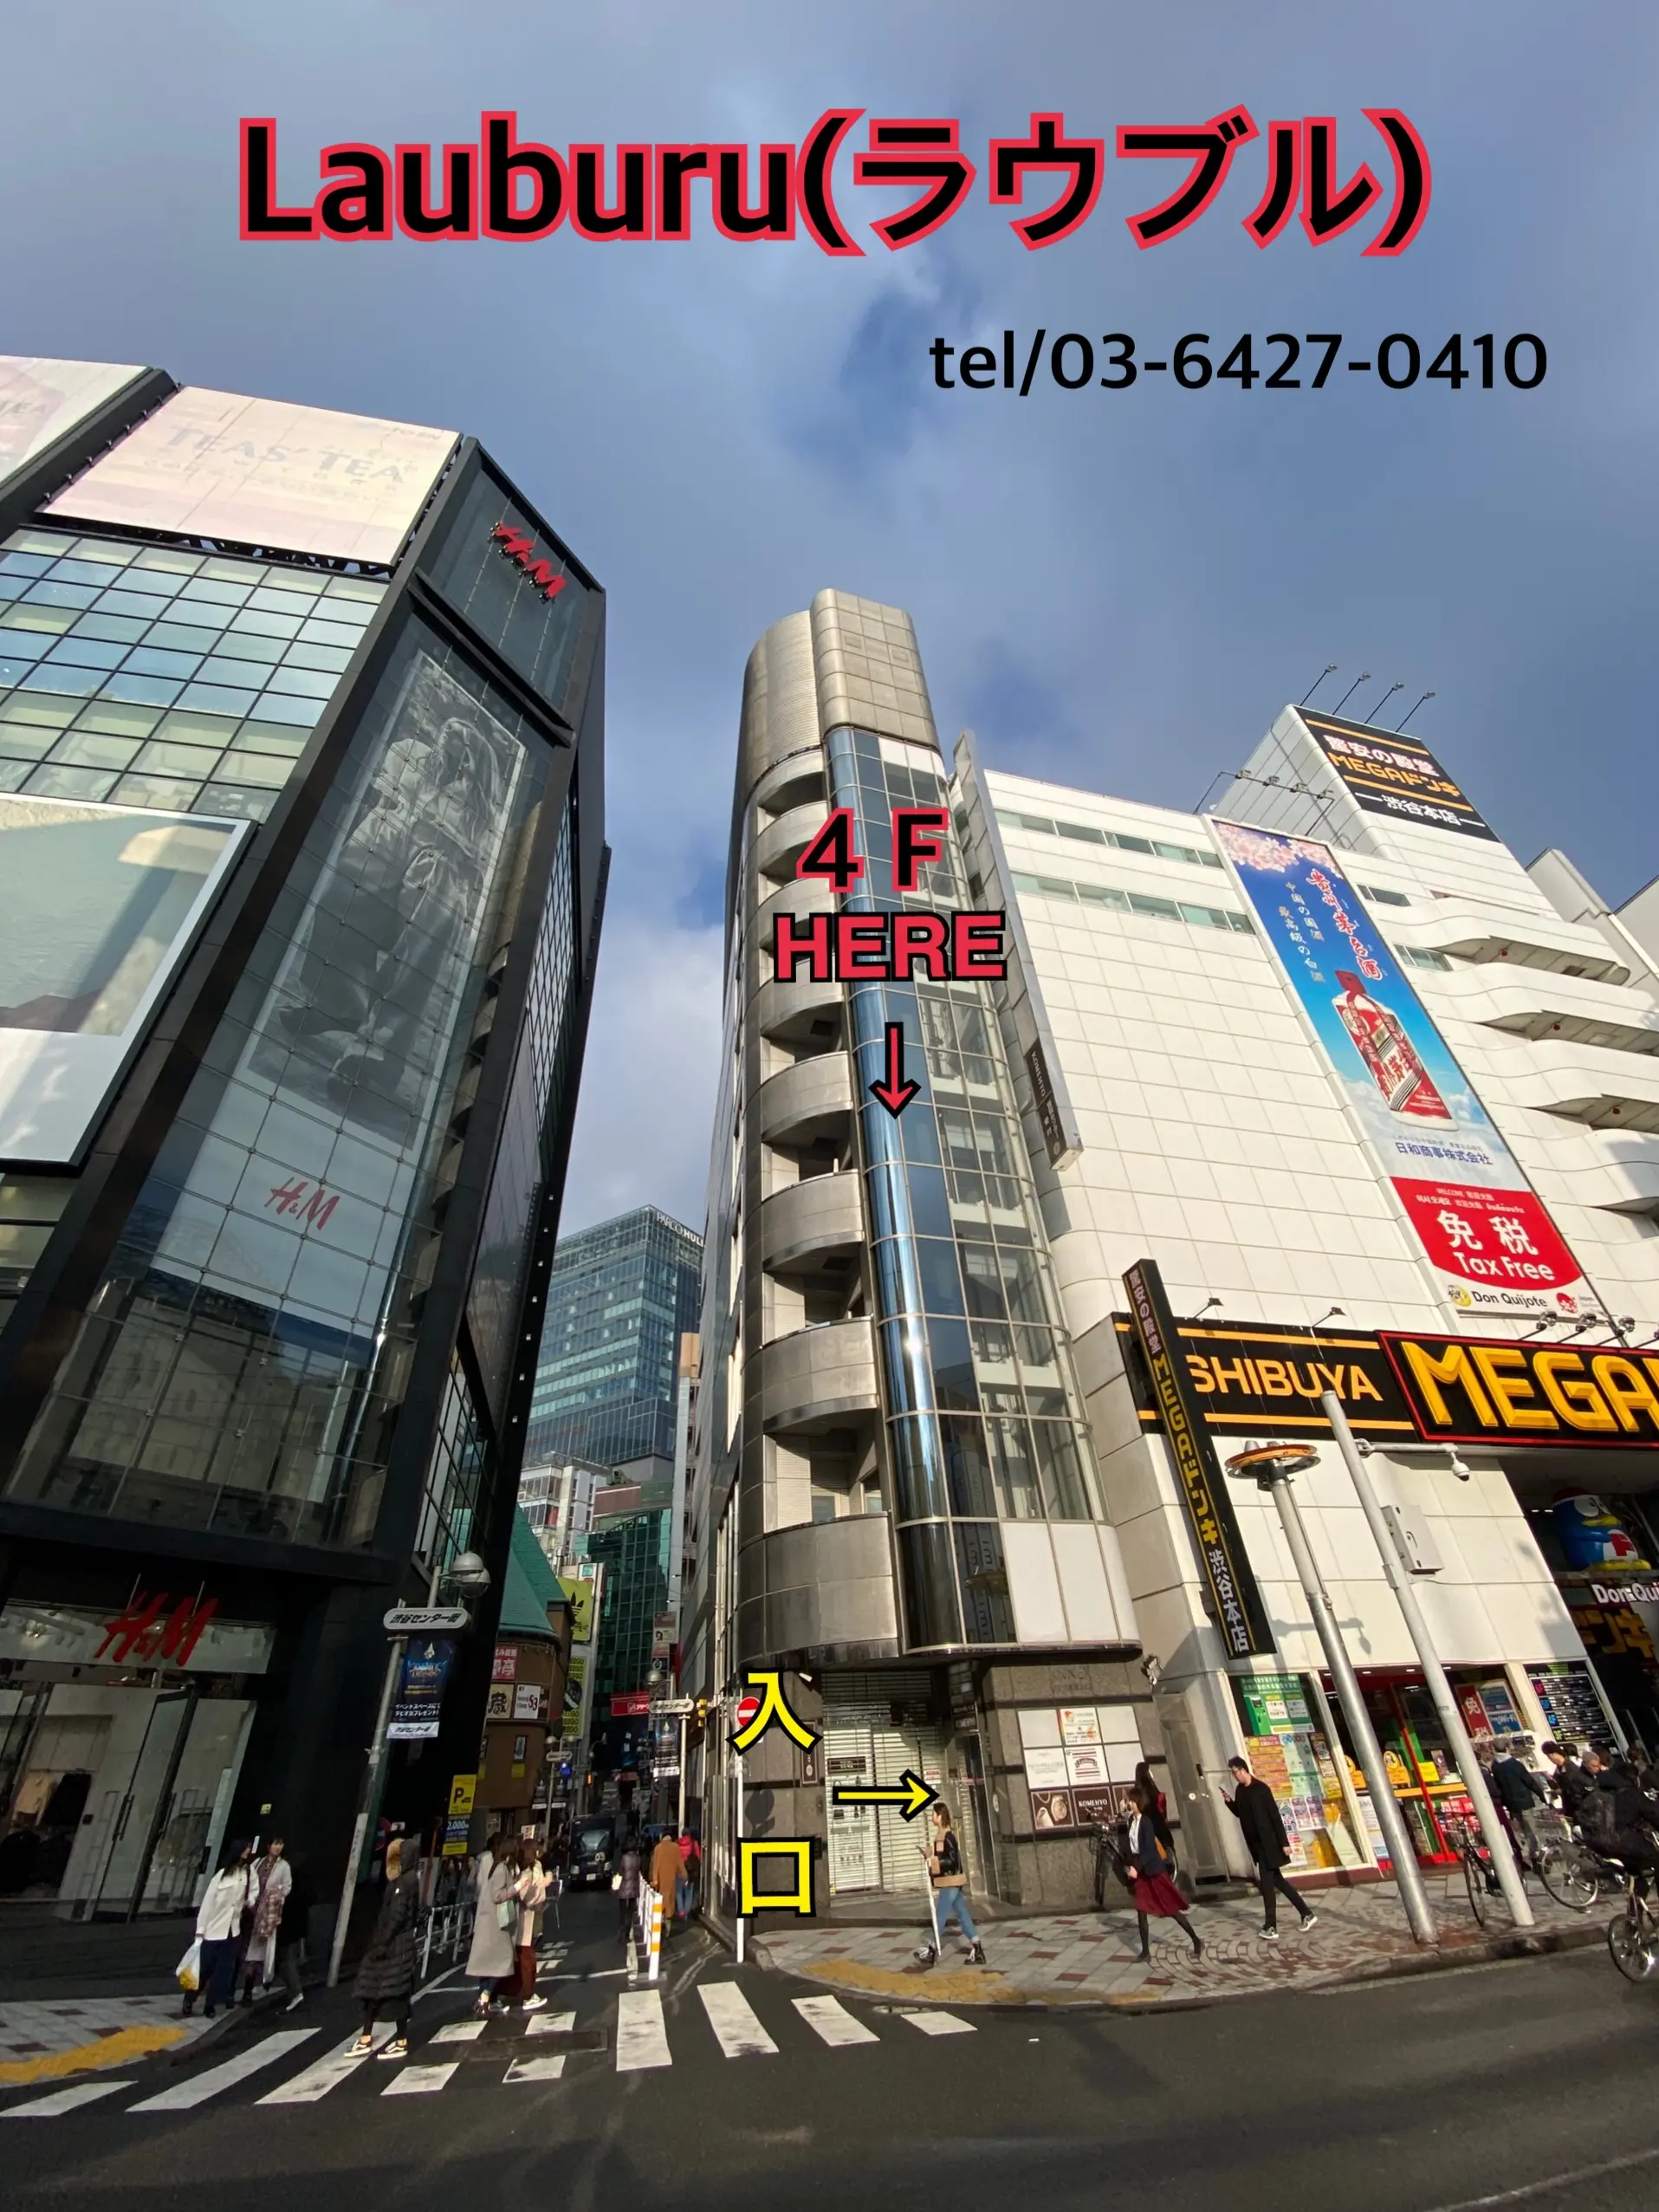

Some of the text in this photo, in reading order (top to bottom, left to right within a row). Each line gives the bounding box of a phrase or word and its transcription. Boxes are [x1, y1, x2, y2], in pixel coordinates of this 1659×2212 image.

[317, 450, 405, 483] TEA
[492, 522, 567, 600] H&M
[1327, 752, 1461, 797] MEGAドンキ
[1381, 794, 1461, 826] 渋谷本店
[1031, 1050, 1047, 1098] KOMEHYO
[1395, 1141, 1494, 1165] 日和商事株式会社
[263, 1176, 340, 1231] H&M
[1436, 1209, 1539, 1255] 免税
[1453, 1251, 1556, 1281] Tax Free
[1471, 1290, 1547, 1308] Don Quijote
[1185, 1354, 1384, 1402] SHIBUYA
[1401, 1341, 1659, 1432] MEGA
[1152, 1352, 1218, 1546] MEGAドンキ
[1209, 1549, 1250, 1653] 渋谷本店
[1631, 1582, 1659, 1604] Qui
[94, 1591, 219, 1668] H&M
[389, 1612, 462, 1625] 渋谷センター街
[1078, 1799, 1108, 1808] KOMEHYO
